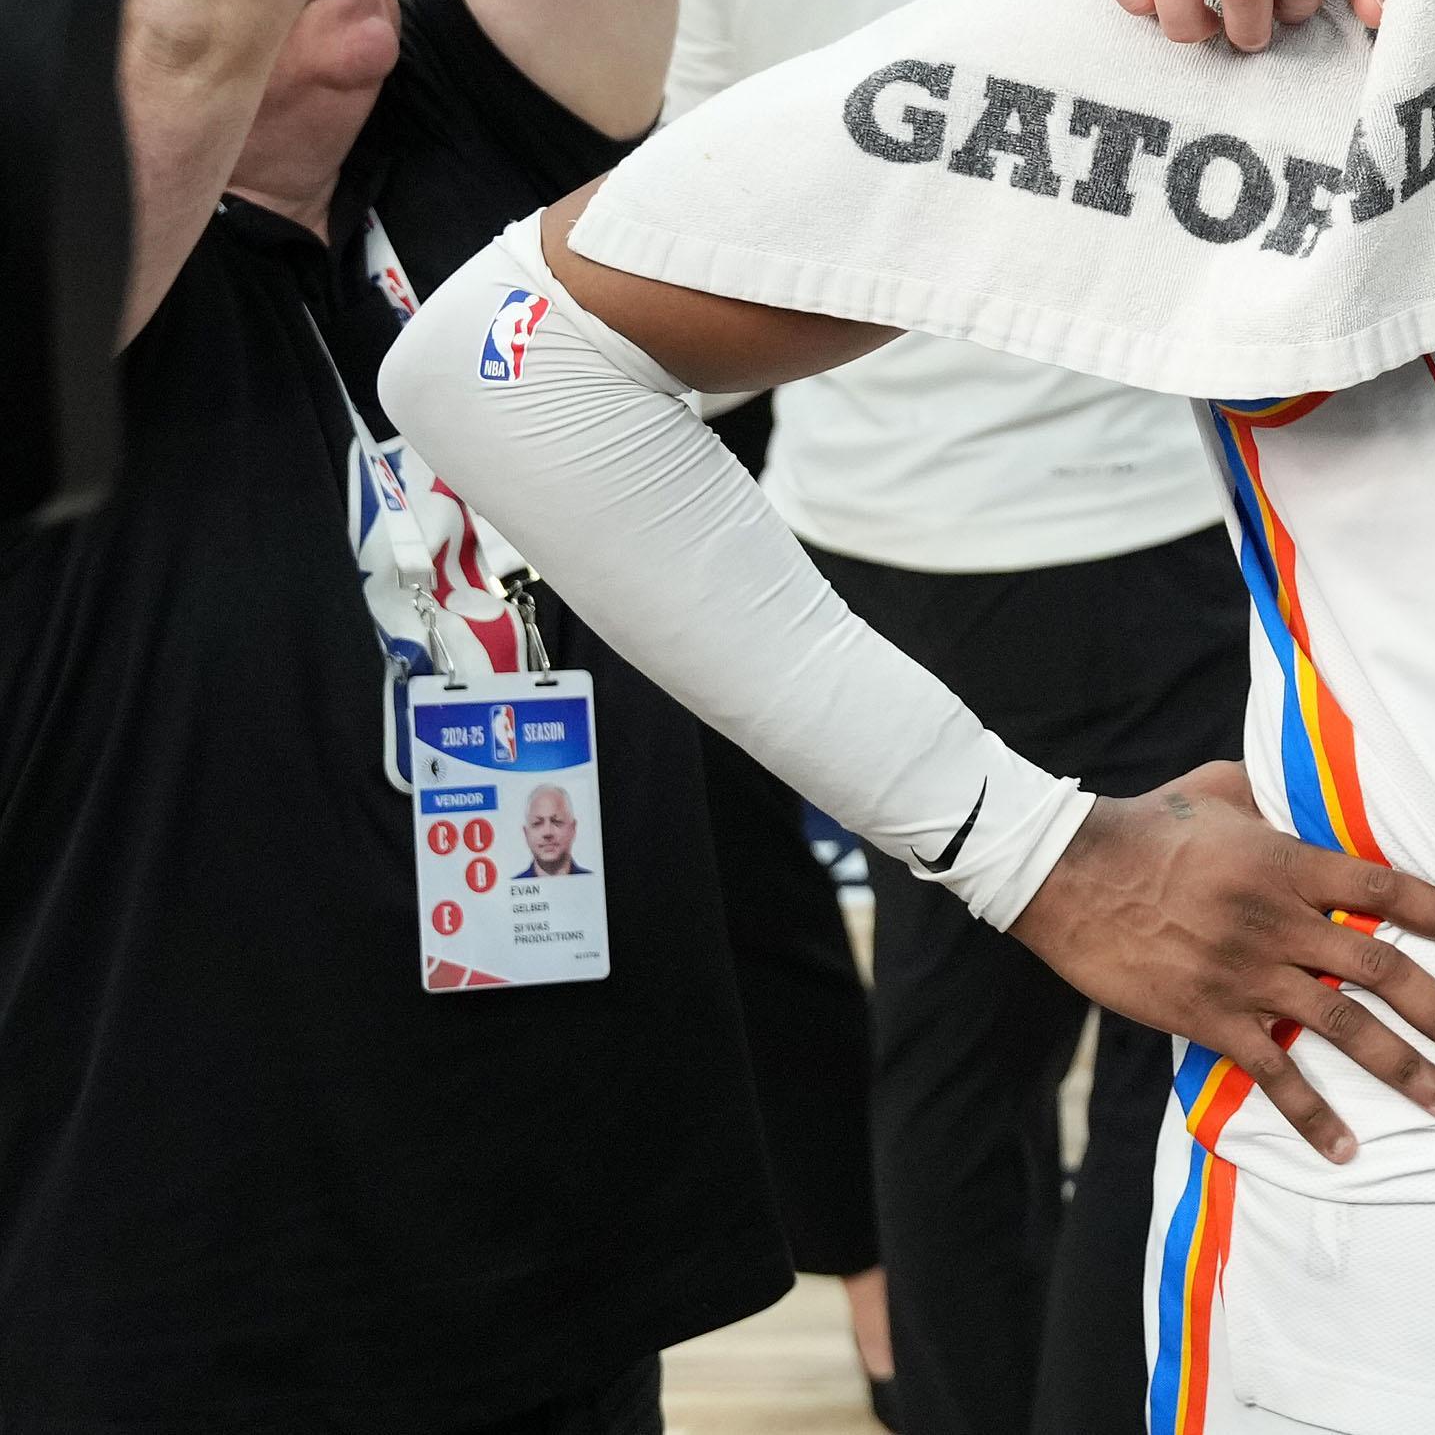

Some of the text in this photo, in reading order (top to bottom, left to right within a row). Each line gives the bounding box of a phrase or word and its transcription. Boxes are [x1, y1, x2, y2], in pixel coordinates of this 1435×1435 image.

[484, 359, 506, 378] NBA
[441, 721, 566, 747] 2024-25 SEASON
[434, 792, 485, 808] VENDOR
[511, 885, 541, 896] EVAN
[442, 906, 453, 931] E
[514, 931, 585, 945] PRODUCTIONS
